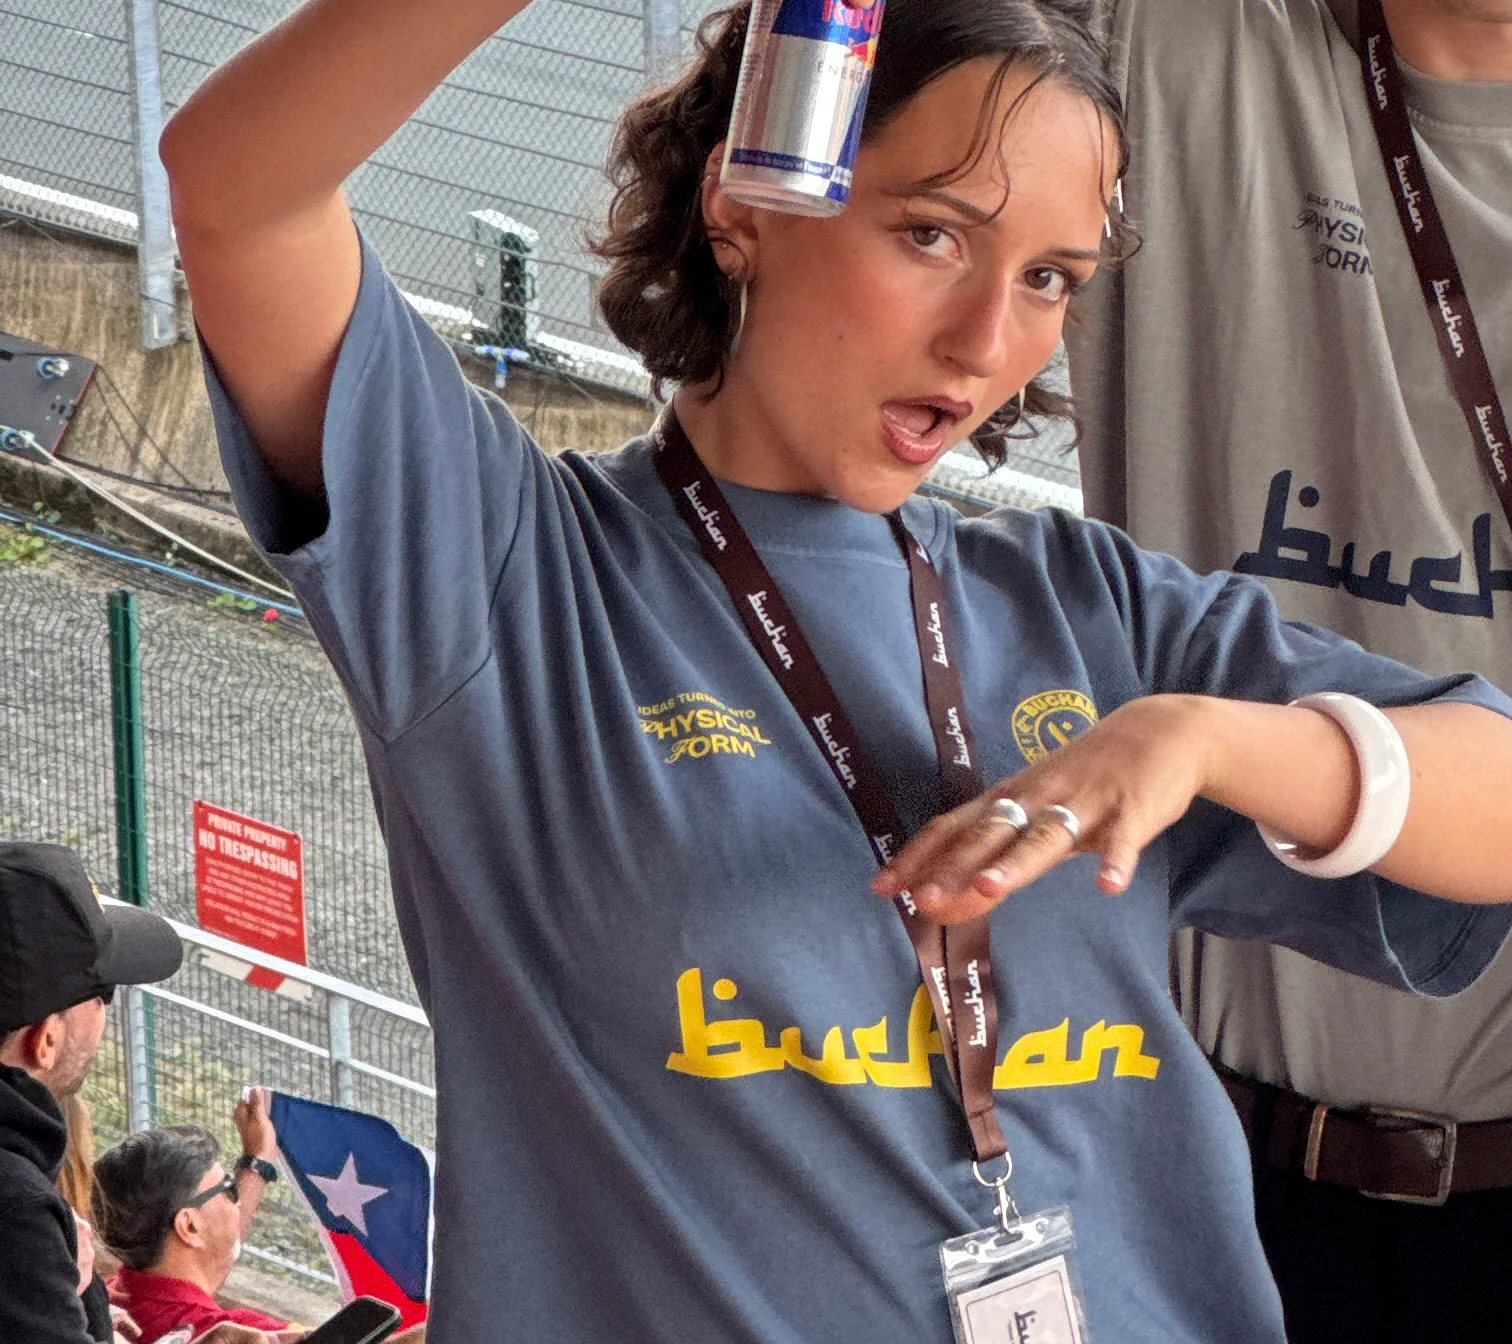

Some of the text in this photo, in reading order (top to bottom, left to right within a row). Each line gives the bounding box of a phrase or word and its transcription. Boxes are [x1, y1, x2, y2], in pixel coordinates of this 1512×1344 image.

[1366, 34, 1389, 111] buchan
[1393, 155, 1425, 234] buchan
[1431, 279, 1465, 359] buchan
[1474, 405, 1509, 484] buchan
[683, 480, 728, 552] buchan
[747, 590, 796, 671] buchan
[927, 601, 950, 669] buchan
[637, 697, 677, 716] IDEAS
[639, 708, 773, 745] PHYSICAL
[945, 706, 972, 770] buchan
[663, 733, 757, 765] FORM
[812, 712, 858, 790] buchan
[198, 827, 299, 881] NO TRESPASSING
[207, 812, 288, 852] PRIVATE PROPERTY
[967, 959, 988, 1047] buchan
